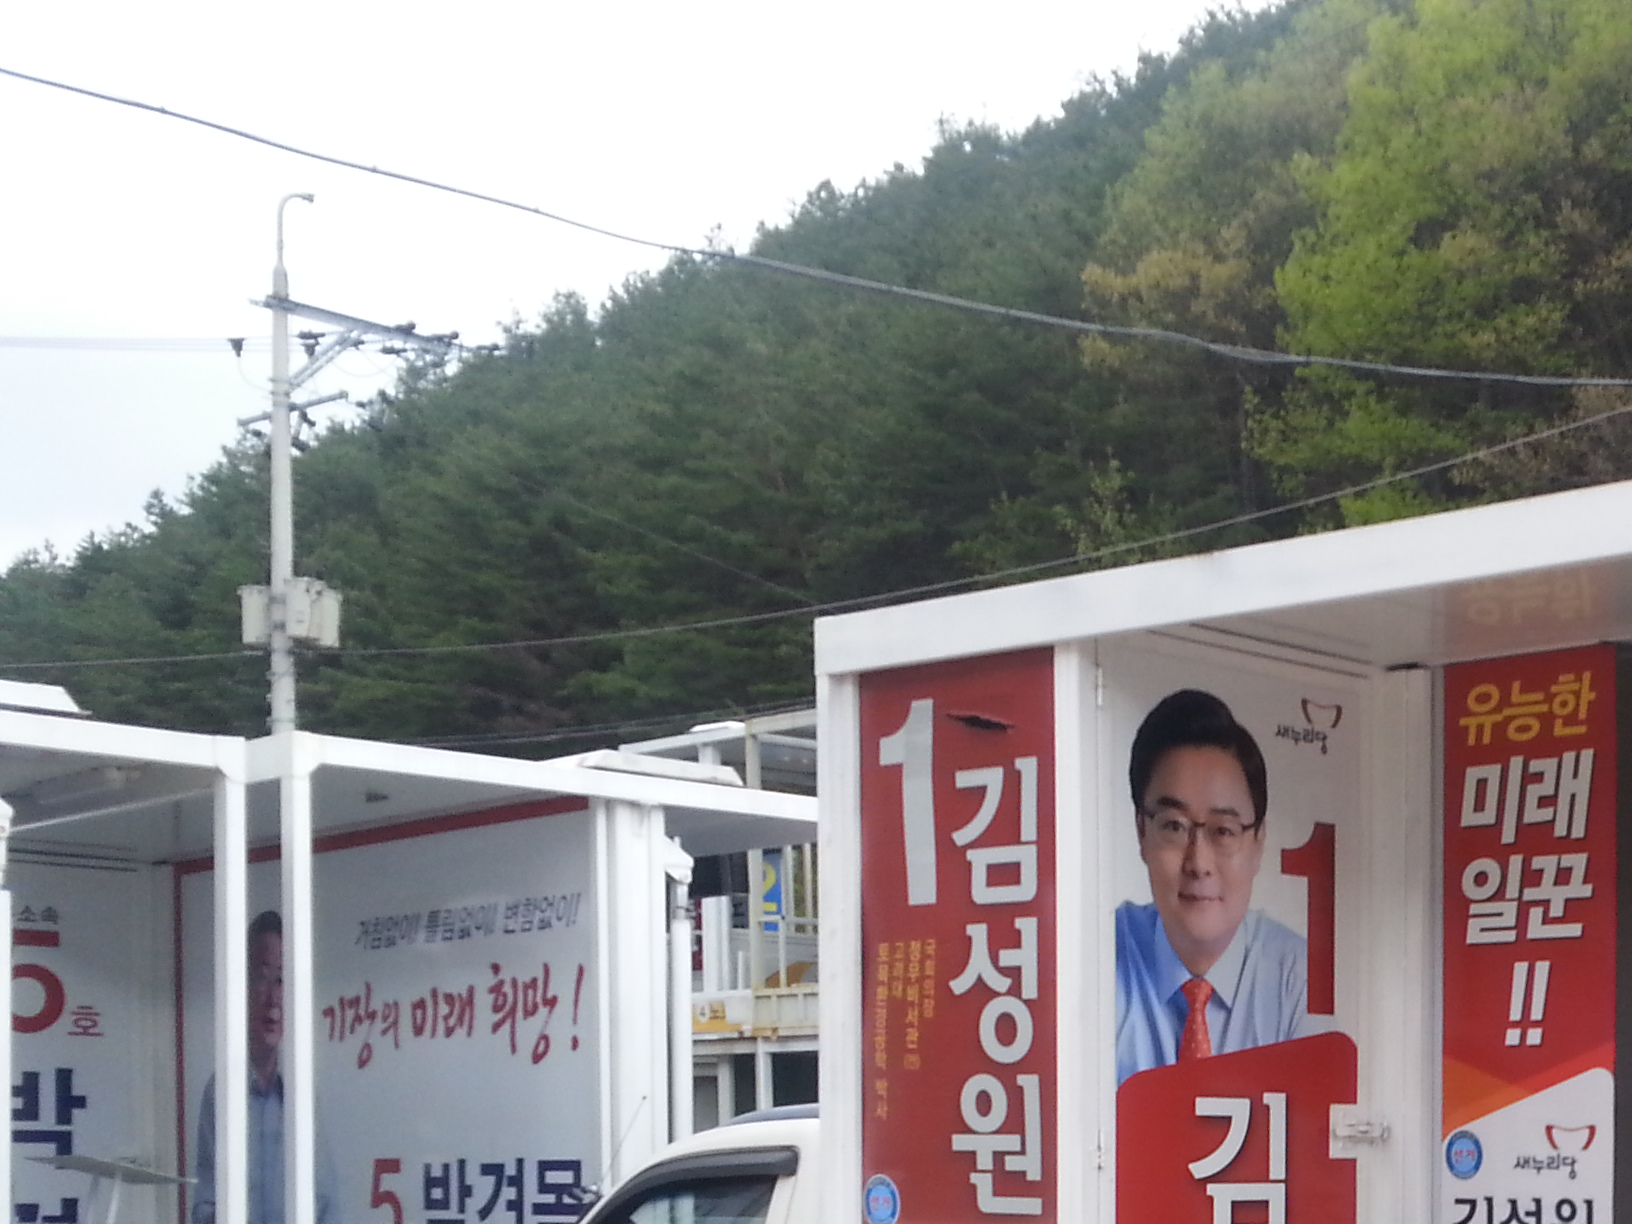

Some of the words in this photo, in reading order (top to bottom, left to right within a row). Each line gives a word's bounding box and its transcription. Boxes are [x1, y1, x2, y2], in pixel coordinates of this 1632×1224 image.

[1459, 671, 1595, 745] 유능한
[878, 698, 936, 906] 1
[1460, 748, 1595, 845] 미래
[1281, 822, 1336, 1015] 1
[1460, 853, 1594, 945] 일꾼
[411, 984, 477, 1039] 미래
[949, 756, 1043, 1216] 김성원
[1513, 1152, 1577, 1179] 새누리당
